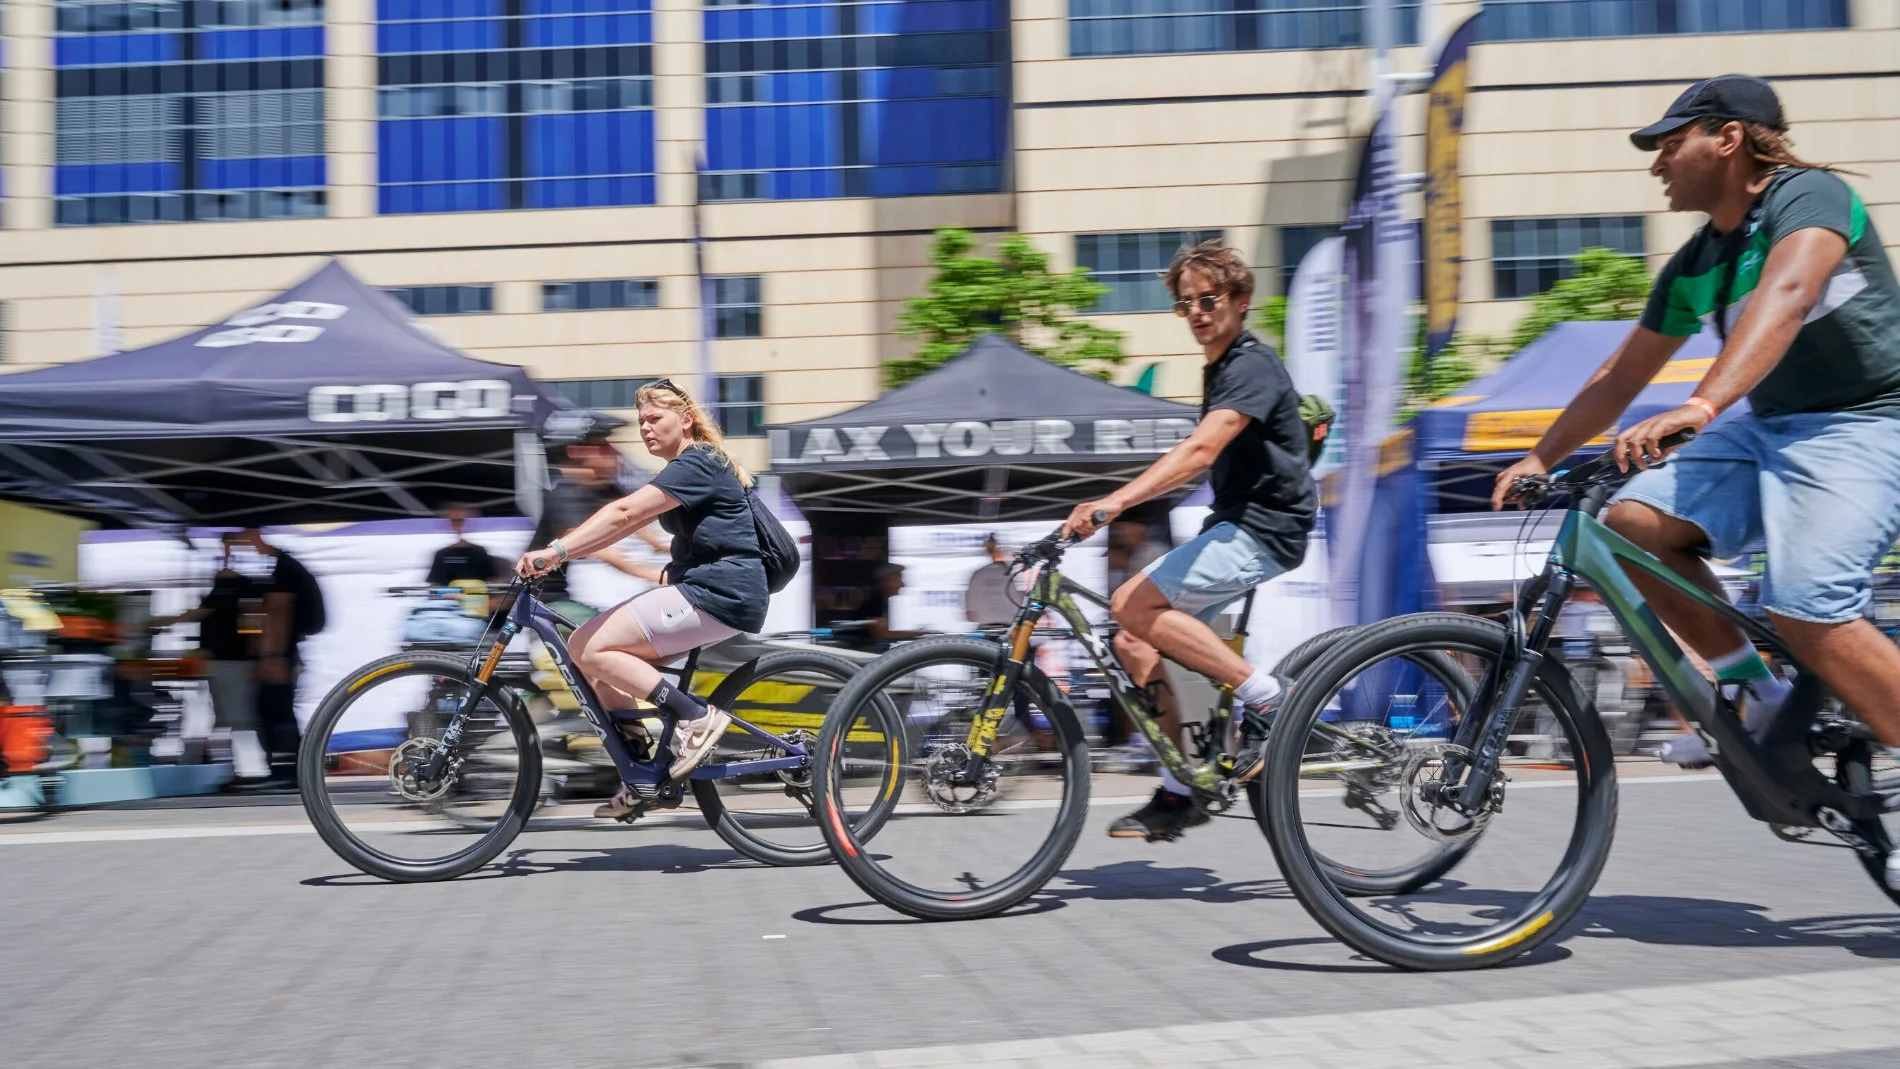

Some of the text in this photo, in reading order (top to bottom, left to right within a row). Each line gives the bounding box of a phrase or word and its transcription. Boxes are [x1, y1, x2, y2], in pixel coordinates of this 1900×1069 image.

[902, 419, 1075, 457] YOUR
[1094, 418, 1199, 454] RID
[544, 641, 607, 741] ORBEA
